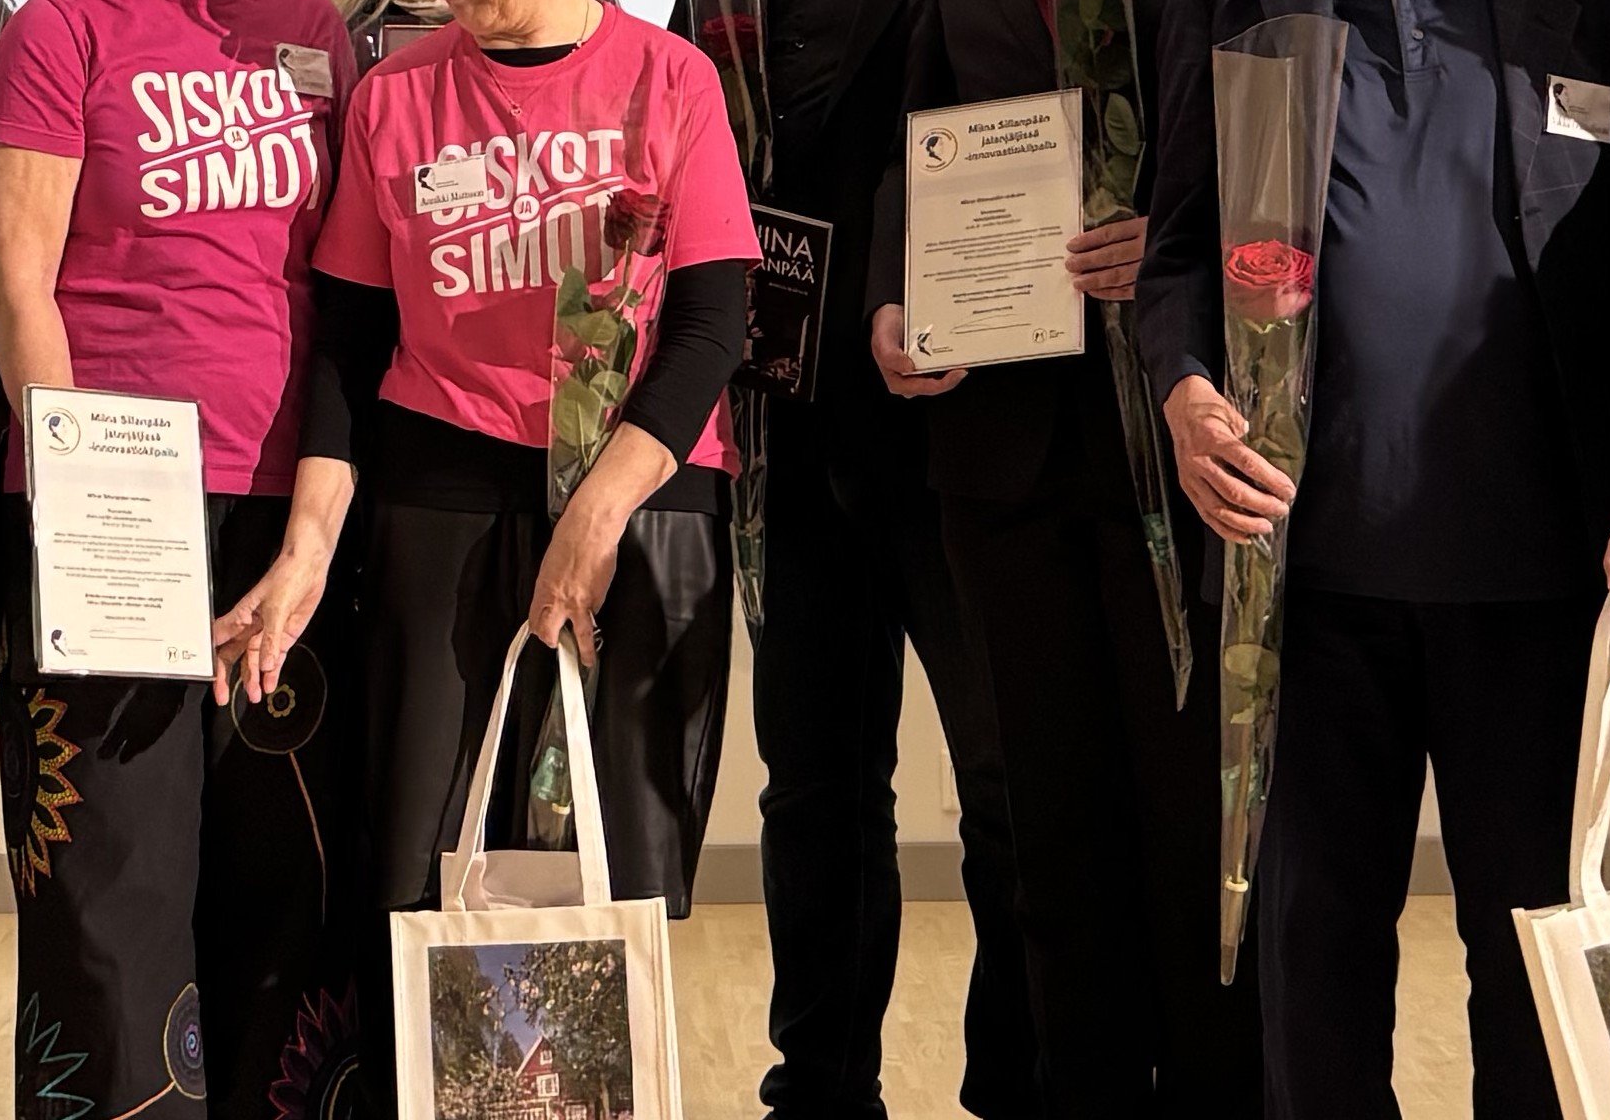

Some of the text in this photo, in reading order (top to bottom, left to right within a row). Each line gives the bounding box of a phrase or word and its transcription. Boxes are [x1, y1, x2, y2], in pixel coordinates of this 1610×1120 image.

[140, 123, 321, 218] SIMOT
[518, 200, 533, 215] JA
[757, 224, 814, 263] IINA
[760, 257, 815, 284] ANPÄÄ
